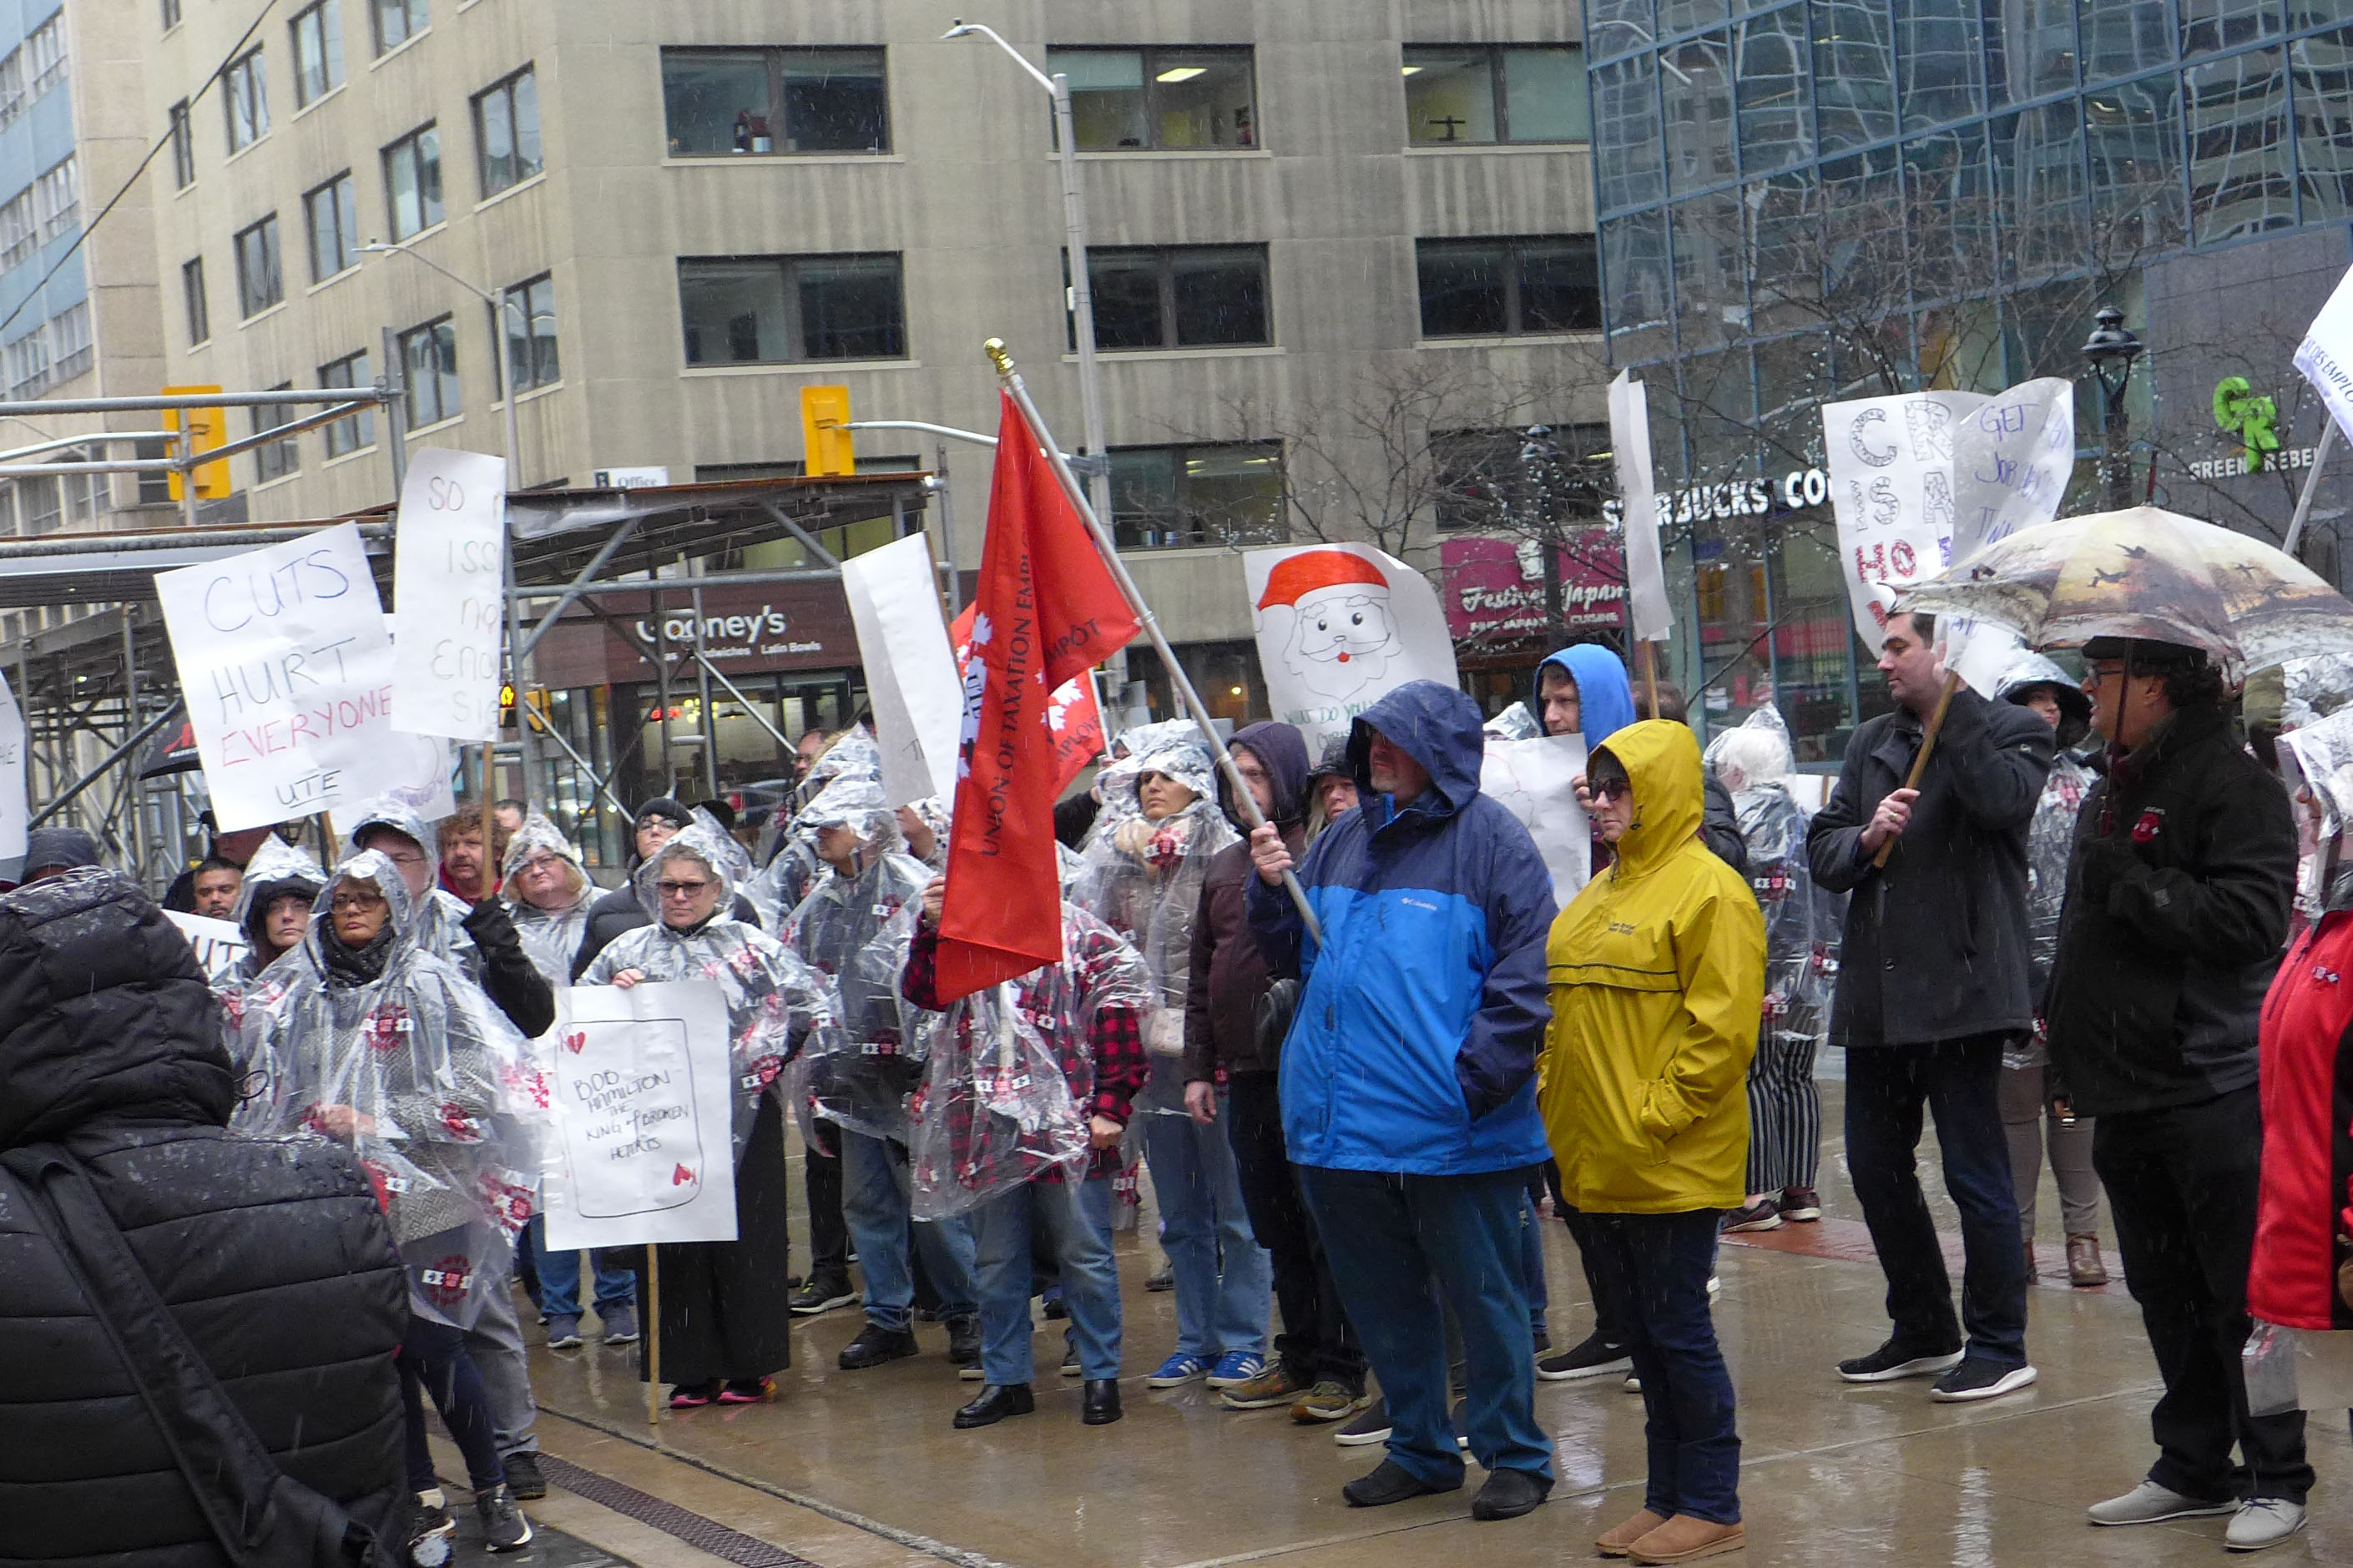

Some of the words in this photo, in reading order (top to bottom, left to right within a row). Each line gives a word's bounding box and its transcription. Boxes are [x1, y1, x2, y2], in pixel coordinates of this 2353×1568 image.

[1980, 404, 2040, 441] GET
[2189, 456, 2249, 481] GREEN
[1602, 478, 1769, 533] SRBUCKS
[205, 549, 349, 633] CUTS
[1461, 584, 1547, 613] Festiva
[760, 643, 788, 655] Latin
[789, 640, 823, 653] Bowls
[212, 637, 356, 725] HURT
[1002, 618, 1032, 731] TAXATION
[221, 684, 394, 767] EVERYONE
[997, 739, 1016, 769] OF
[275, 769, 341, 805] UTE
[982, 775, 1011, 857] UNION
[588, 1070, 671, 1113] HAMILTON
[602, 1098, 634, 1117] THE
[586, 1122, 622, 1142] KING
